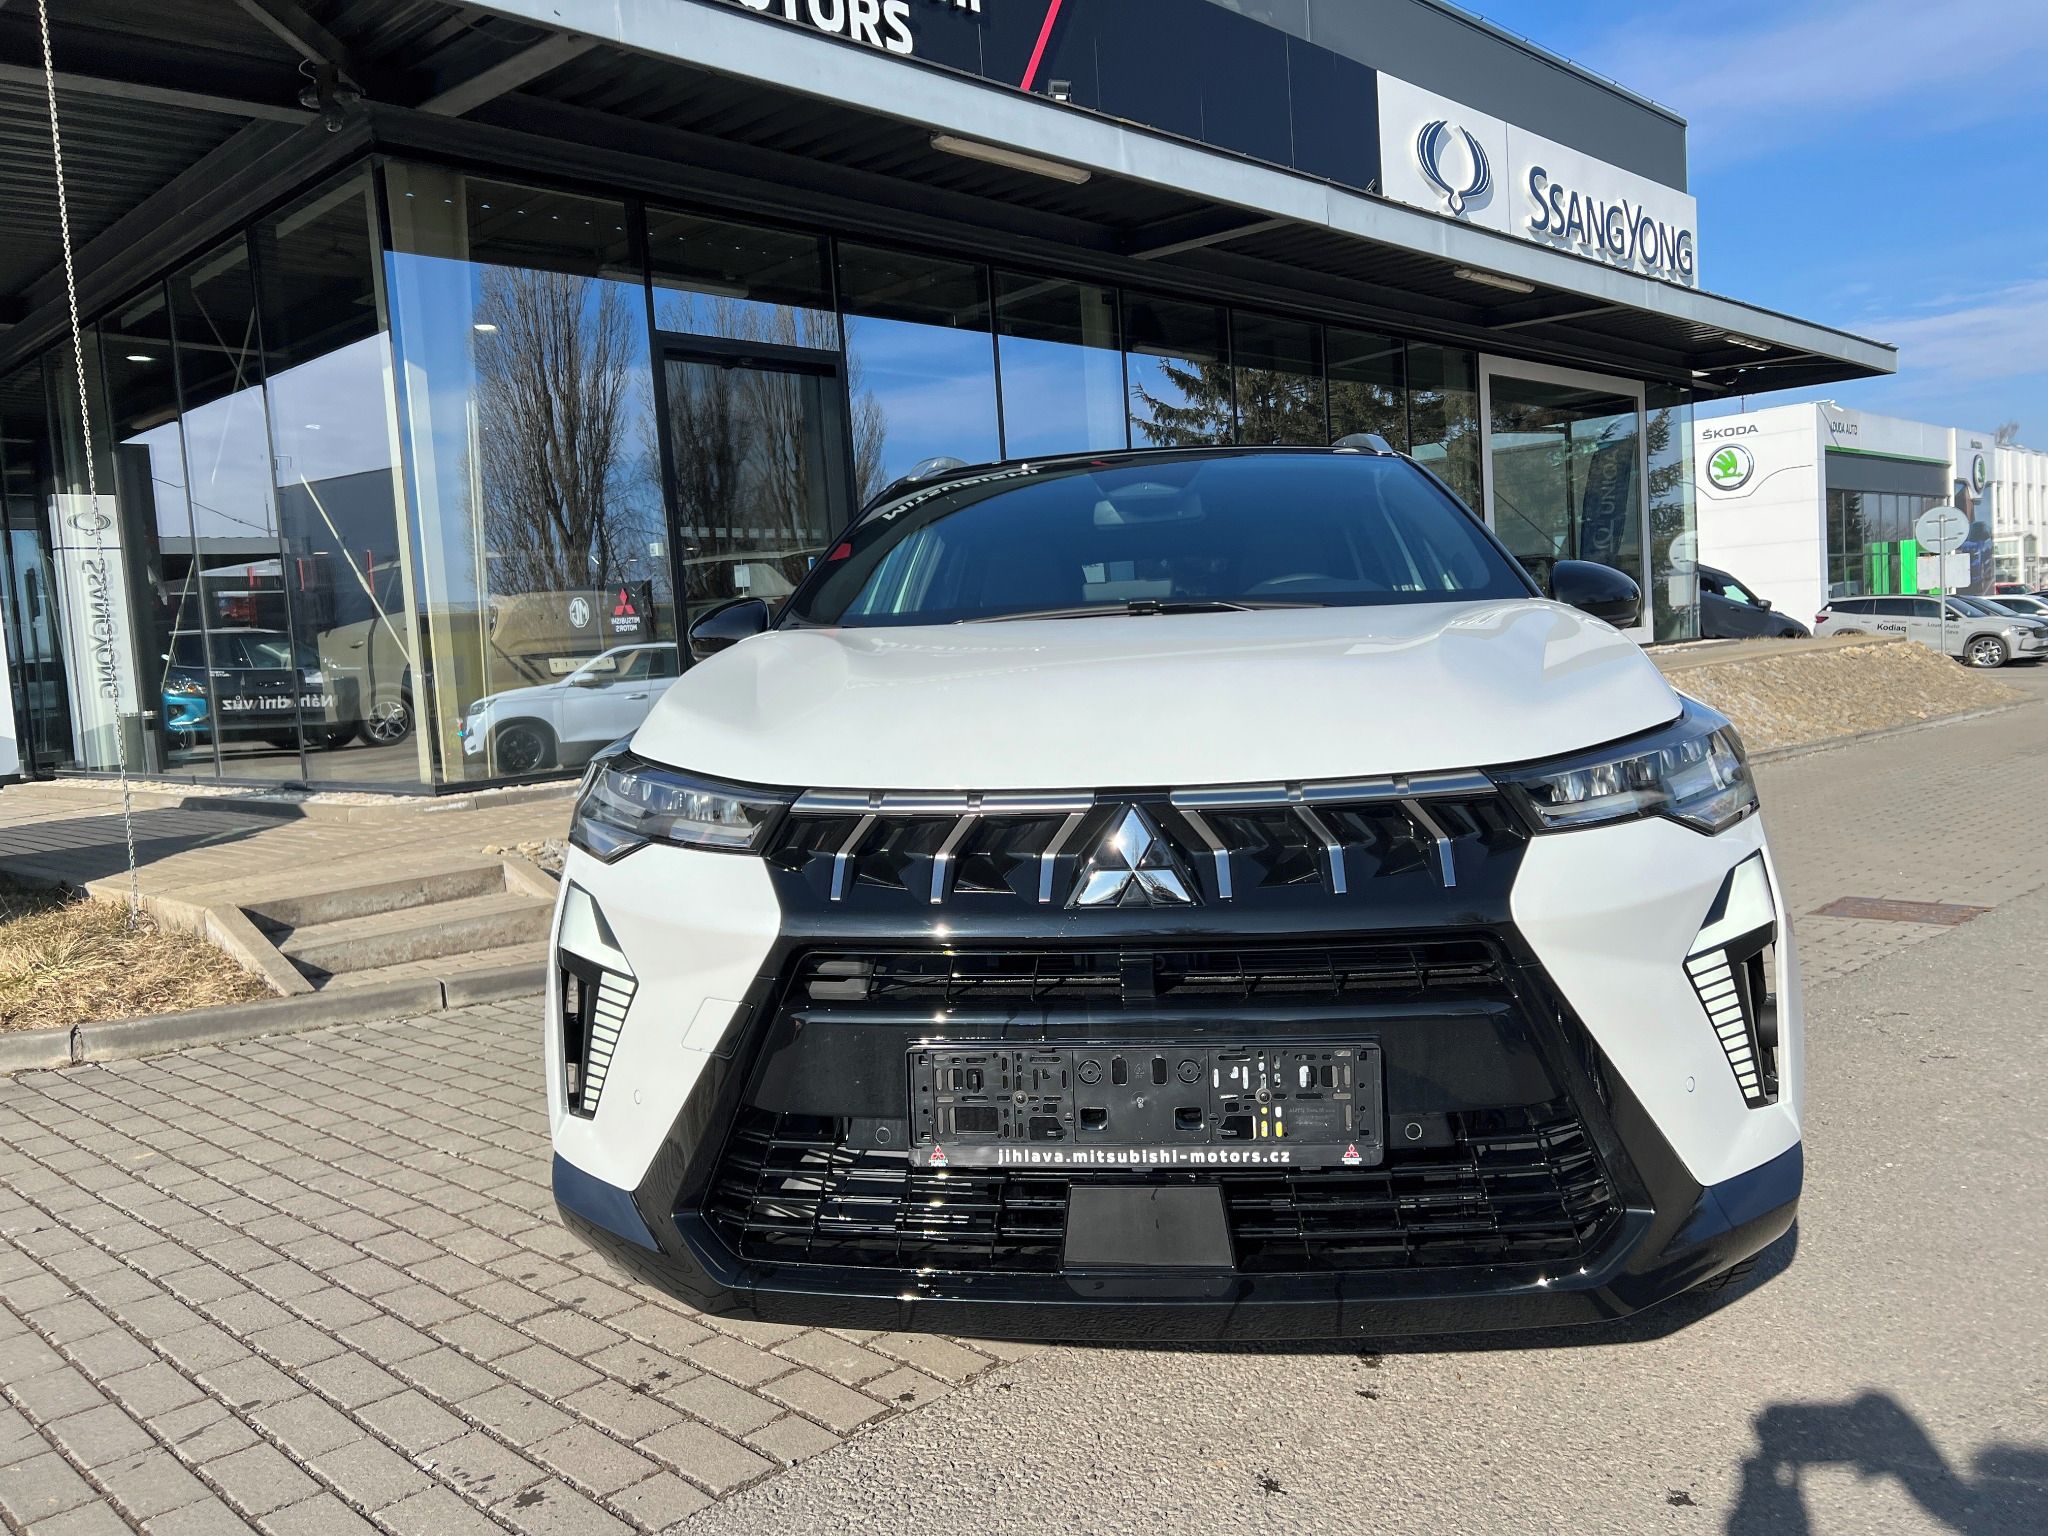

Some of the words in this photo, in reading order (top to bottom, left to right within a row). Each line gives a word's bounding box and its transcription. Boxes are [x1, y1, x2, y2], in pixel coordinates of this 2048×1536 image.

[1528, 166, 1693, 275] SSANGYONG
[1702, 424, 1758, 439] ŠKODA
[1877, 623, 1907, 632] Kodiaq
[997, 1149, 1290, 1165] jihlava.mitsubishi-motors.cz
